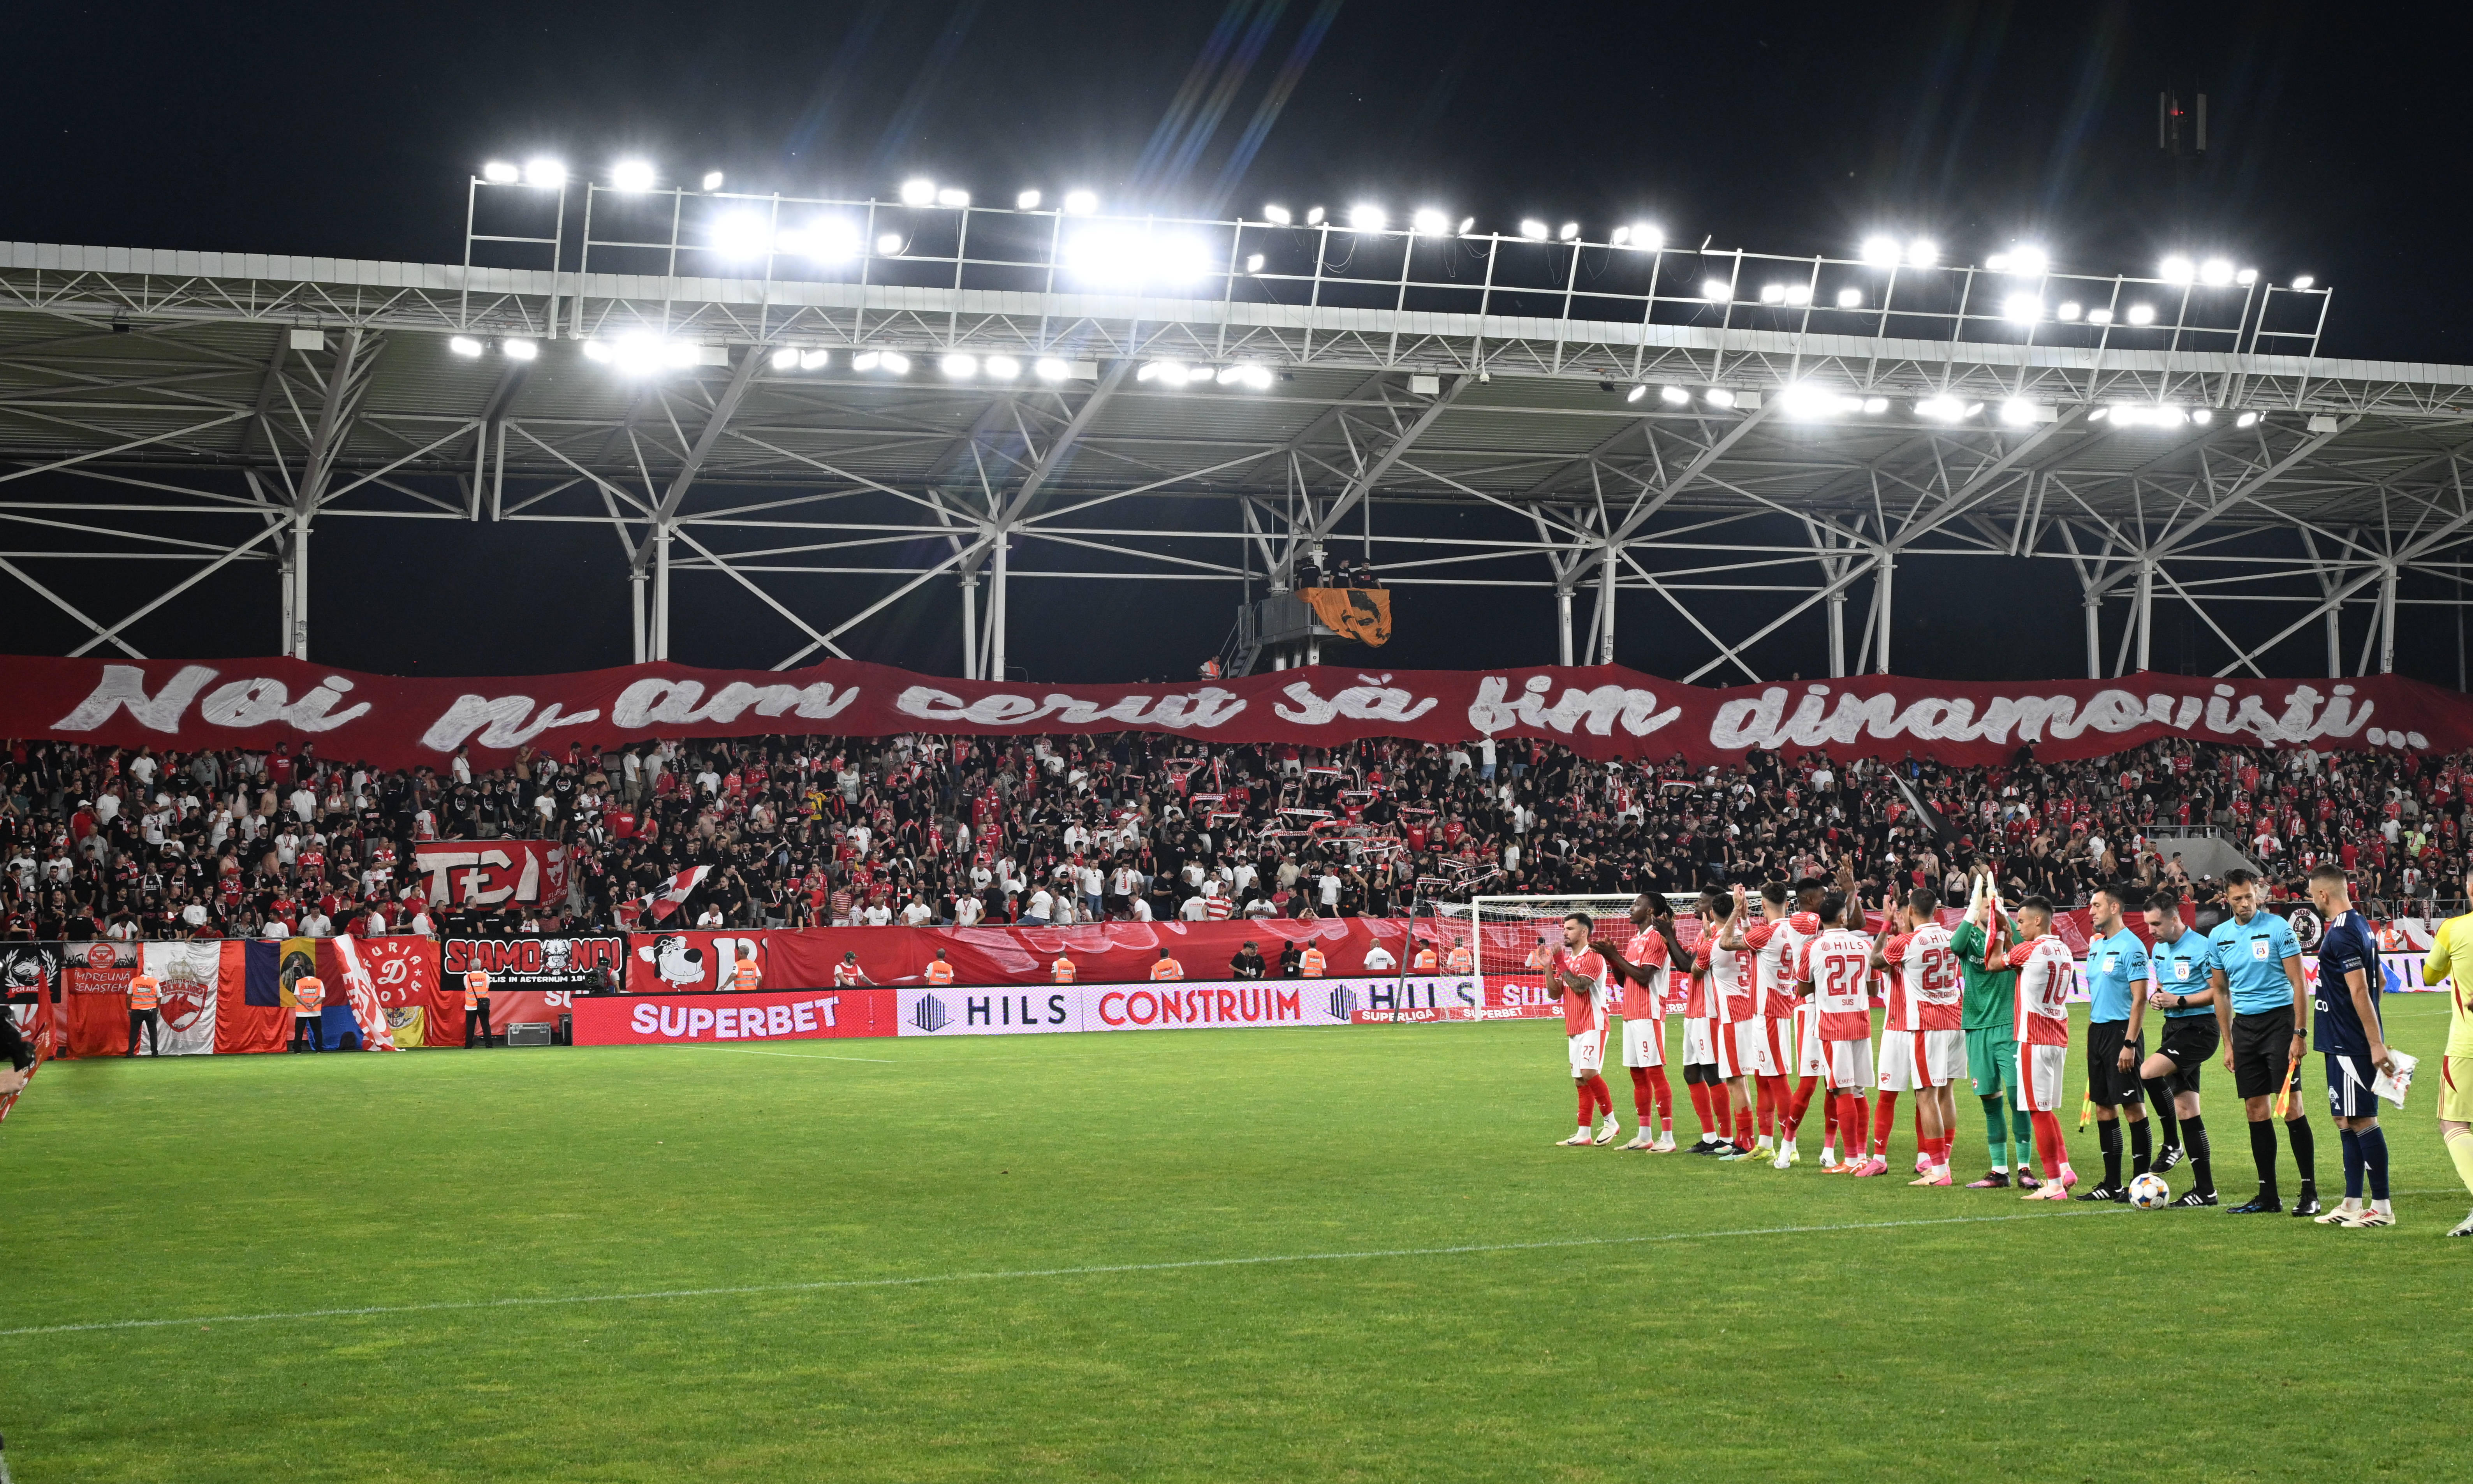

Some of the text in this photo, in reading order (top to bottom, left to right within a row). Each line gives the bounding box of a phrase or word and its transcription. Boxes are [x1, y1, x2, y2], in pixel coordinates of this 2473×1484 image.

[50, 664, 372, 734] Noi
[897, 687, 1247, 728] cerut
[1275, 673, 1438, 725] să
[1468, 676, 1681, 737] fim
[418, 819, 424, 831] 8
[1931, 931, 1952, 943] HIL
[1834, 942, 1864, 950] HILS
[446, 940, 542, 972] SIAMO
[571, 940, 620, 972] NOI
[74, 970, 130, 981] ÎMPREUNĂ
[1825, 954, 1866, 996] 27
[1922, 947, 1959, 989] 23
[161, 983, 204, 995] DINAMO
[381, 980, 422, 1002] OJA
[2042, 961, 2071, 1005] 10
[967, 988, 1301, 1026] HILS CONSTRUIM
[1361, 1009, 1436, 1022] SUPERLIGA
[630, 996, 840, 1038] SUPERBET
[1583, 1045, 1594, 1056] 77
[1642, 1041, 1648, 1053] 9
[1699, 1039, 1704, 1051] 8
